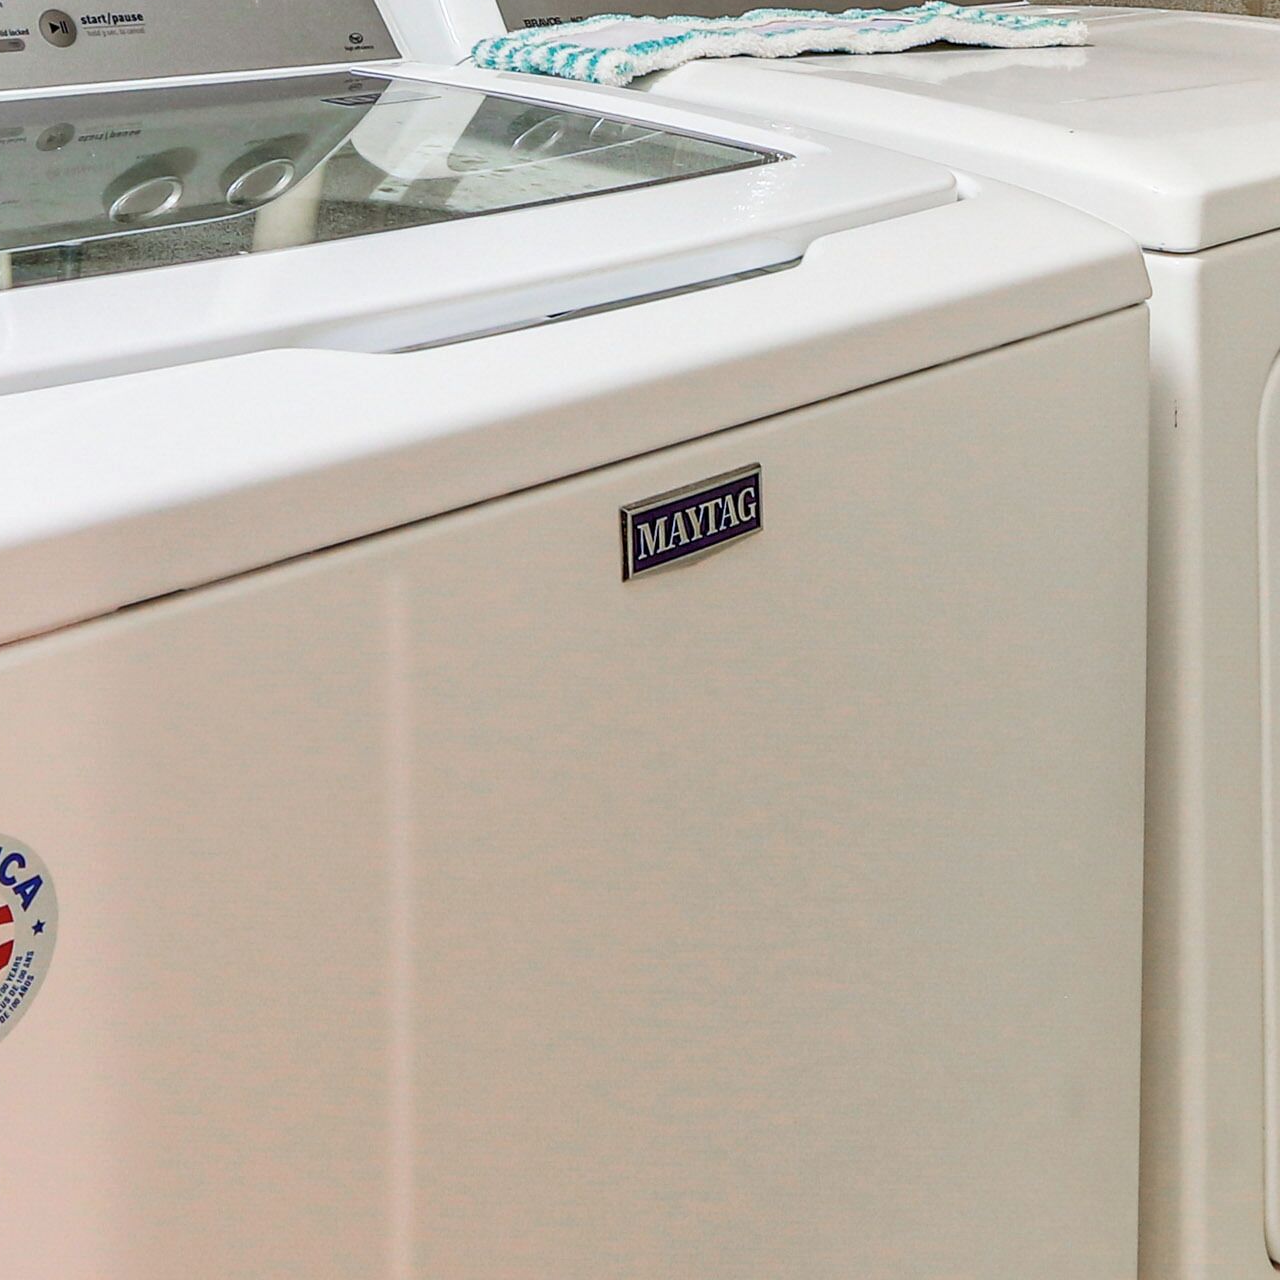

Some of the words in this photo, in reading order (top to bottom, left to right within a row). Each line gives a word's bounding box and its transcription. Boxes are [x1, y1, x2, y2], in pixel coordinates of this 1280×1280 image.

[80, 12, 144, 25] start/pause
[636, 487, 758, 560] MAYTAG
[7, 956, 23, 981] YEARS
[9, 985, 19, 997] DE
[23, 951, 34, 968] ANS
[0, 1012, 10, 1024] DE
